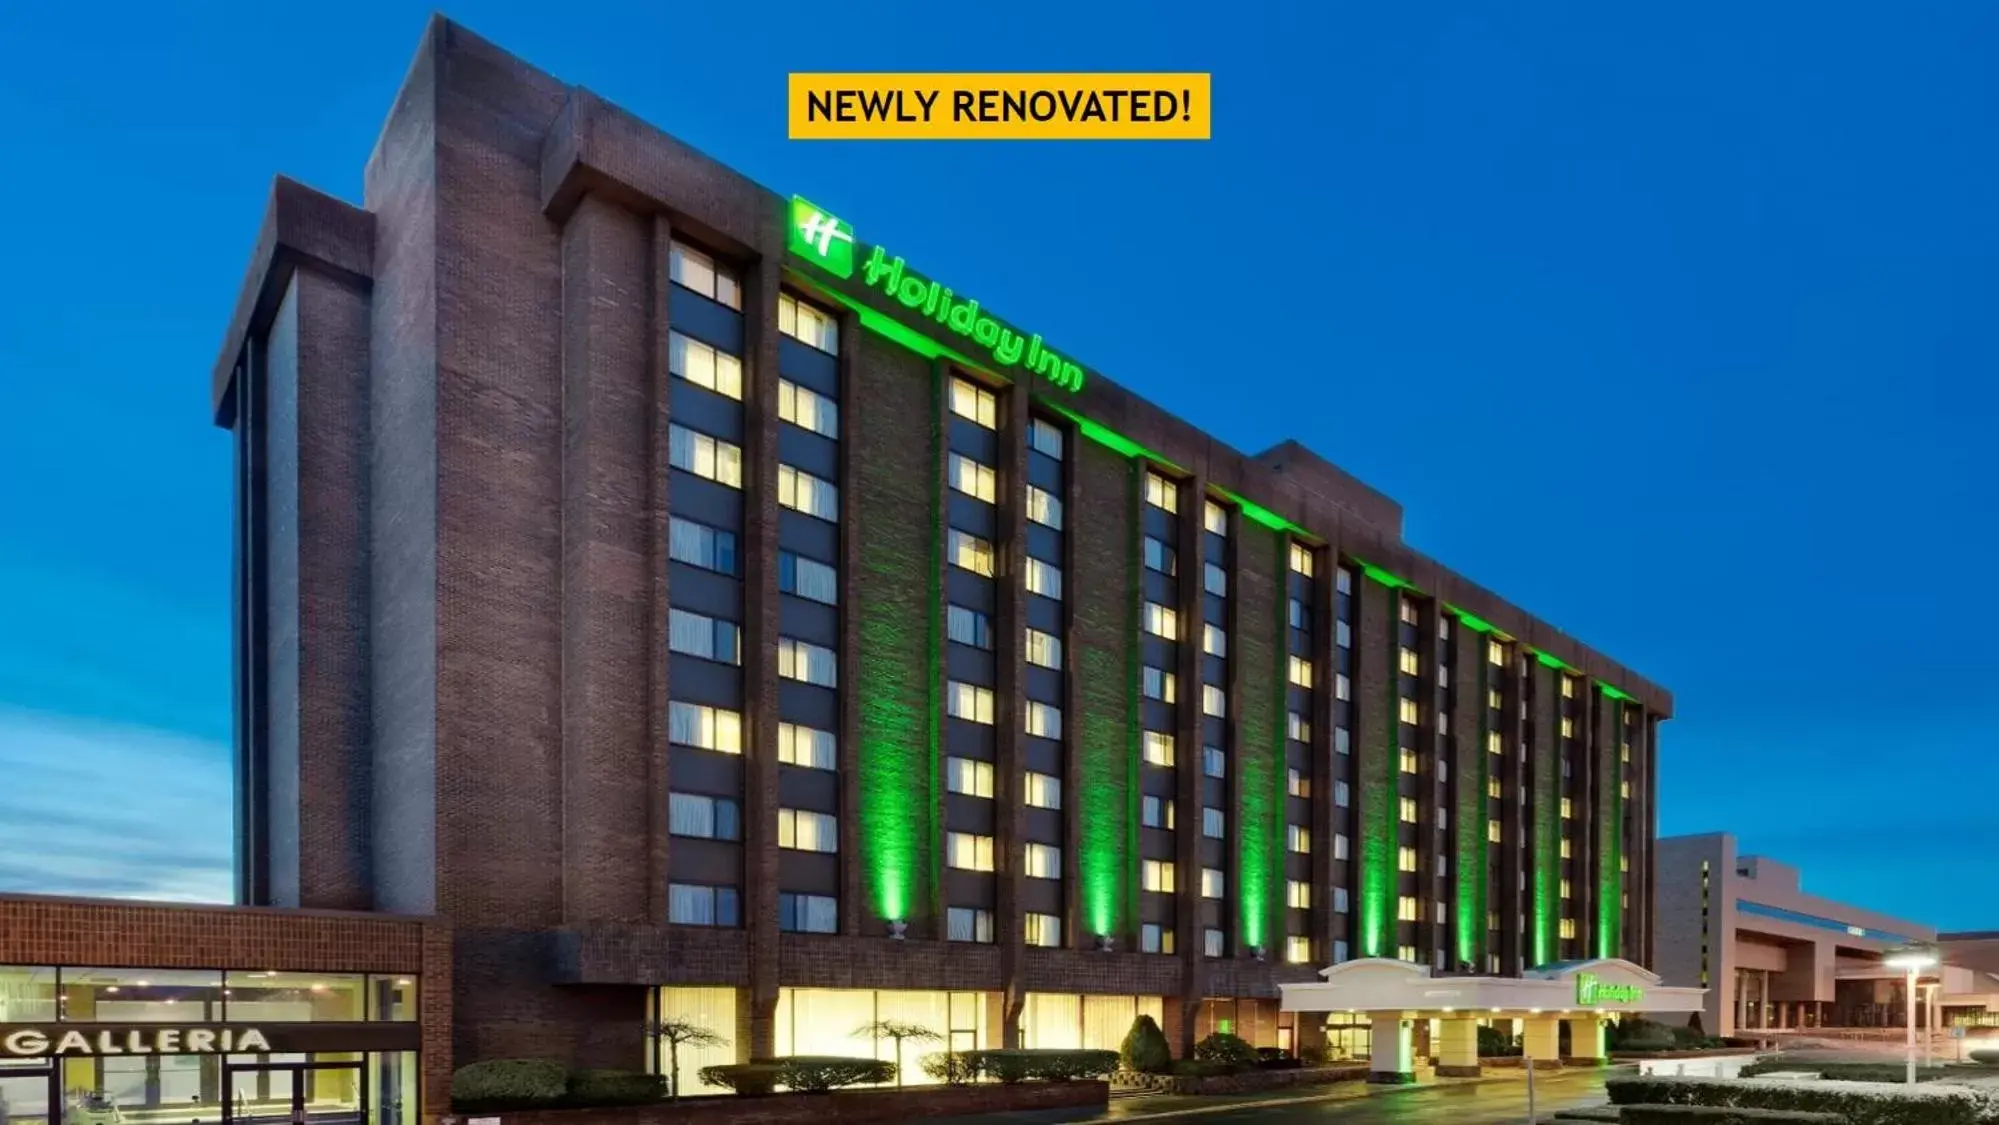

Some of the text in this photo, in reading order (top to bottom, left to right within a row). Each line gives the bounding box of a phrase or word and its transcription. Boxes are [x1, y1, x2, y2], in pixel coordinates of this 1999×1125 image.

[862, 245, 1024, 365] Holiday
[1024, 333, 1084, 393] Inn
[5, 1029, 271, 1055] GALLERIA
